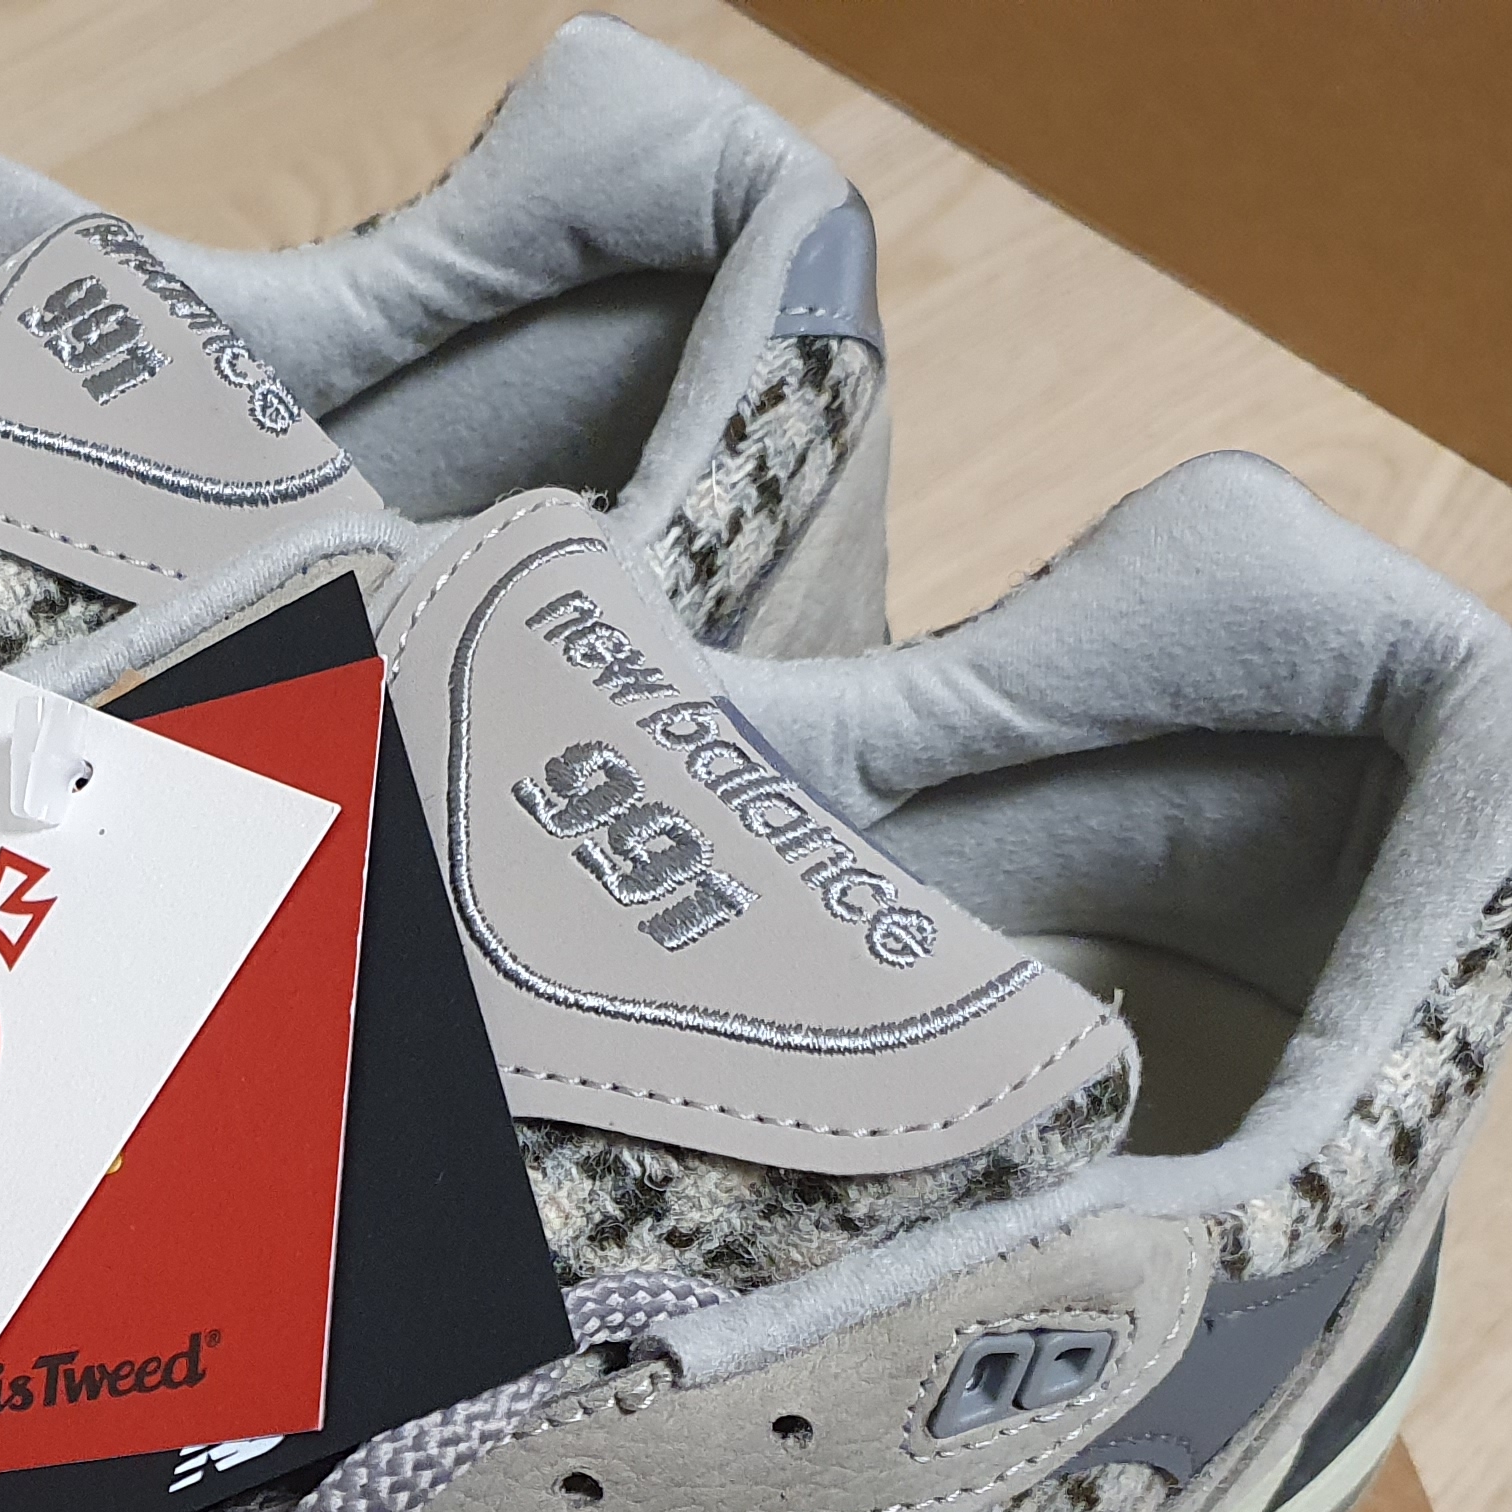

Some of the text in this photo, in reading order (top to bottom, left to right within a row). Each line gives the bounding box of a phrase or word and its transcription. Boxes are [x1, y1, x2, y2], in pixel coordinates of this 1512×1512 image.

[16, 275, 174, 407] 991
[510, 740, 763, 953] 991
[524, 589, 937, 970] new balance
